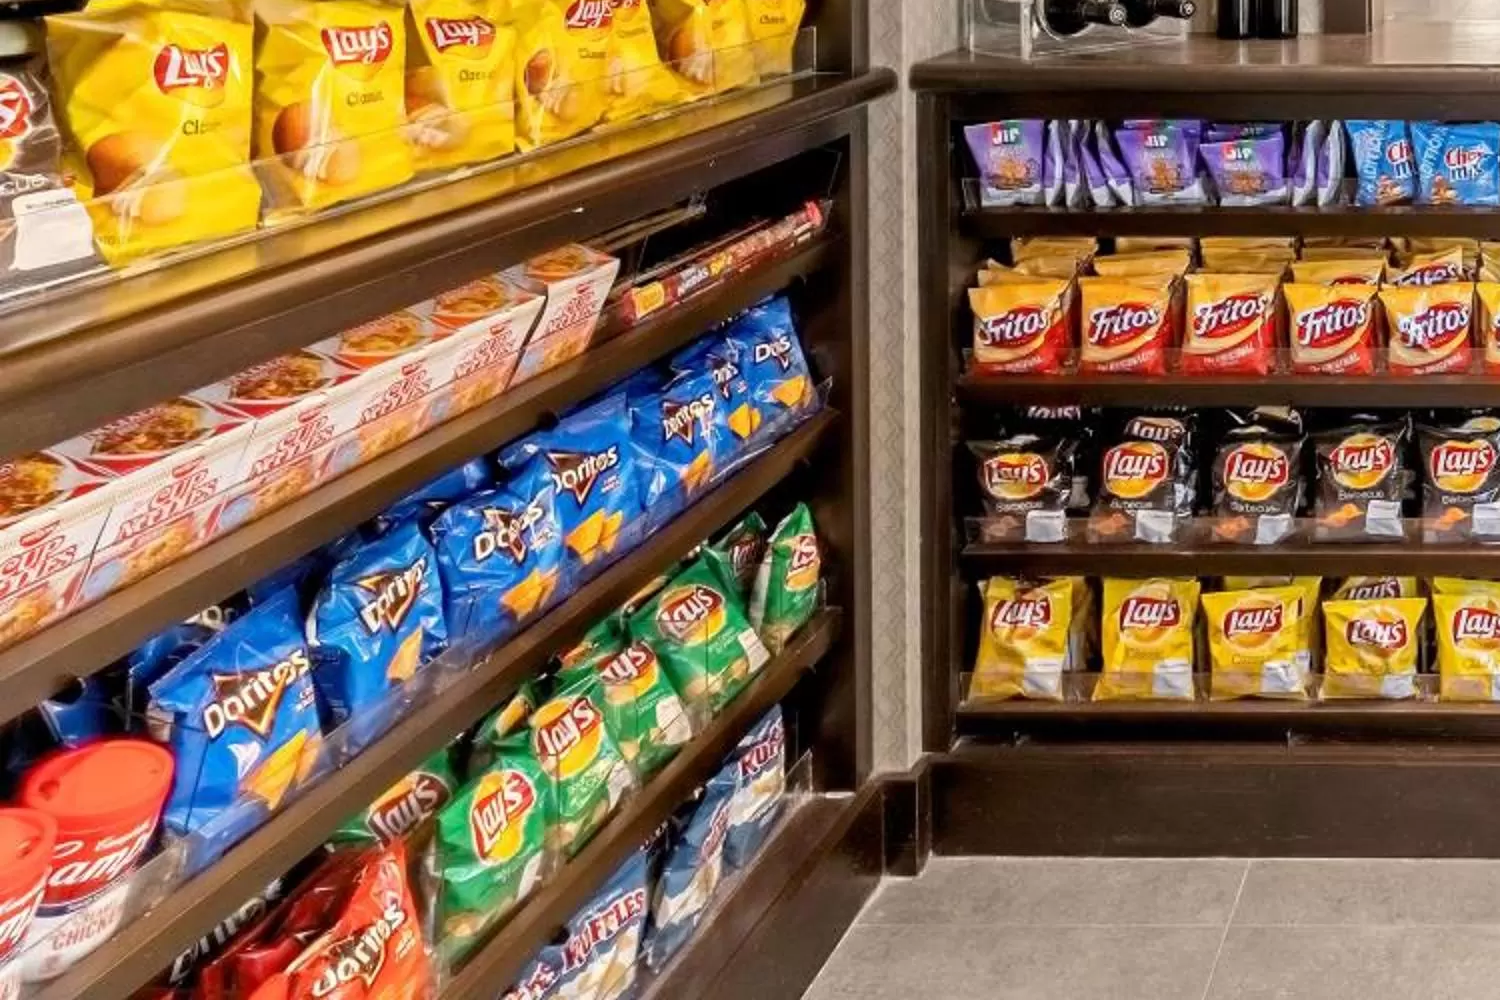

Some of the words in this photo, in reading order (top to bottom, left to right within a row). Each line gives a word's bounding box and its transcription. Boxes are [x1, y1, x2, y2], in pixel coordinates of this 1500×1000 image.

[327, 23, 391, 64] Lay's
[427, 16, 495, 52] Lay's
[983, 308, 1049, 345] Fritos
[1089, 304, 1159, 343] Fritos
[1194, 293, 1268, 334] Fritos
[1297, 300, 1366, 345] Fritos
[1400, 300, 1470, 347] Fritos
[991, 462, 1043, 484] Lay's
[1108, 451, 1164, 479] Lay's
[1231, 455, 1282, 481] Lay's
[1339, 441, 1391, 470] Lay's
[1434, 450, 1489, 475] Lay's
[659, 588, 715, 638] Lay's
[1121, 599, 1179, 629] Lay's
[1229, 605, 1282, 634] Lay's
[203, 648, 310, 740] Doritos
[540, 696, 603, 758] Lay's
[373, 772, 443, 840] Lay's
[474, 771, 534, 852] Lay's
[311, 896, 406, 999] Doritos
[561, 888, 647, 973] RUFFLES
